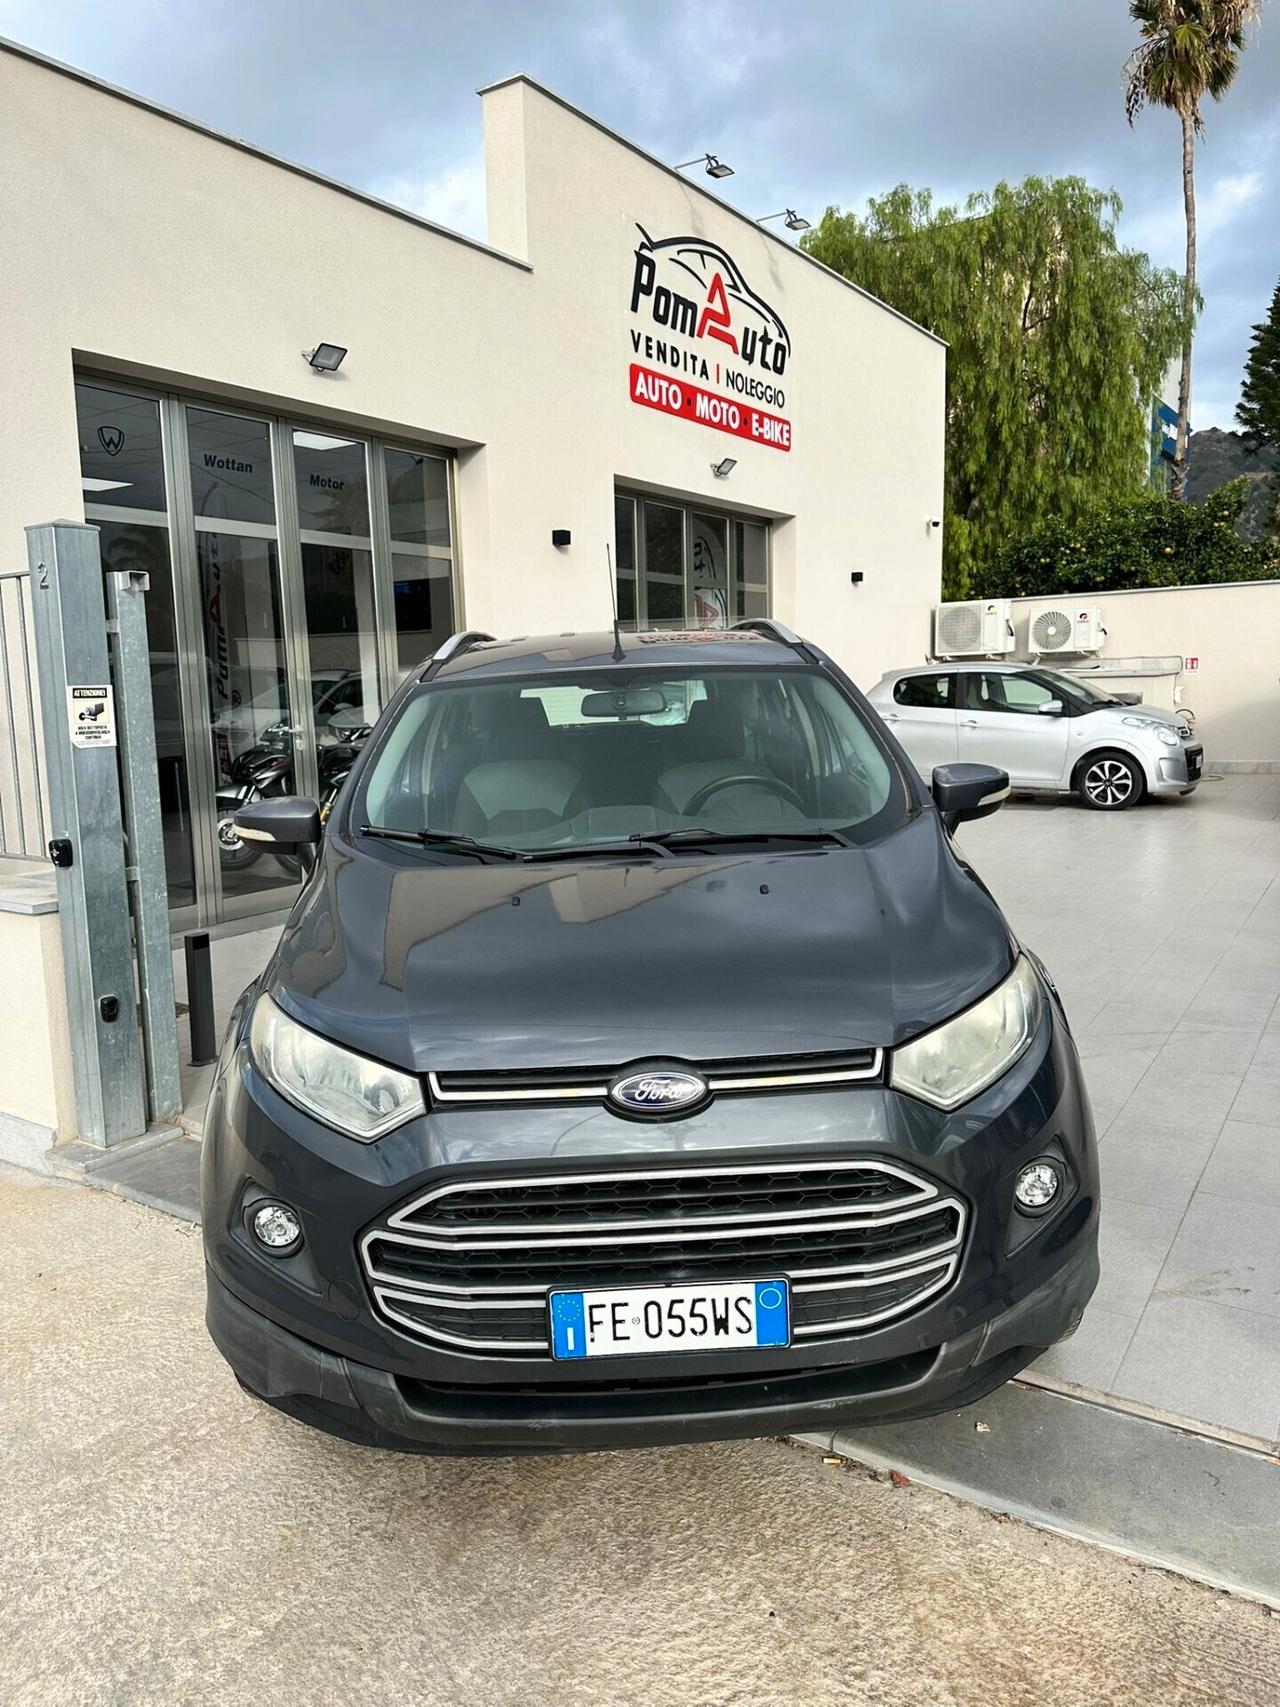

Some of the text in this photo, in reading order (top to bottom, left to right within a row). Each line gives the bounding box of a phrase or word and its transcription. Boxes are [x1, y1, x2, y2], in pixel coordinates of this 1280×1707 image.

[630, 328, 786, 409] VENDITA NOLEGGIO
[634, 371, 791, 446] AUTO MOTO E-BIKE
[203, 453, 253, 474] Wottan
[309, 473, 345, 491] Motor
[37, 561, 50, 590] 2
[634, 1079, 684, 1100] Ford
[588, 1296, 754, 1343] FE 055WS
